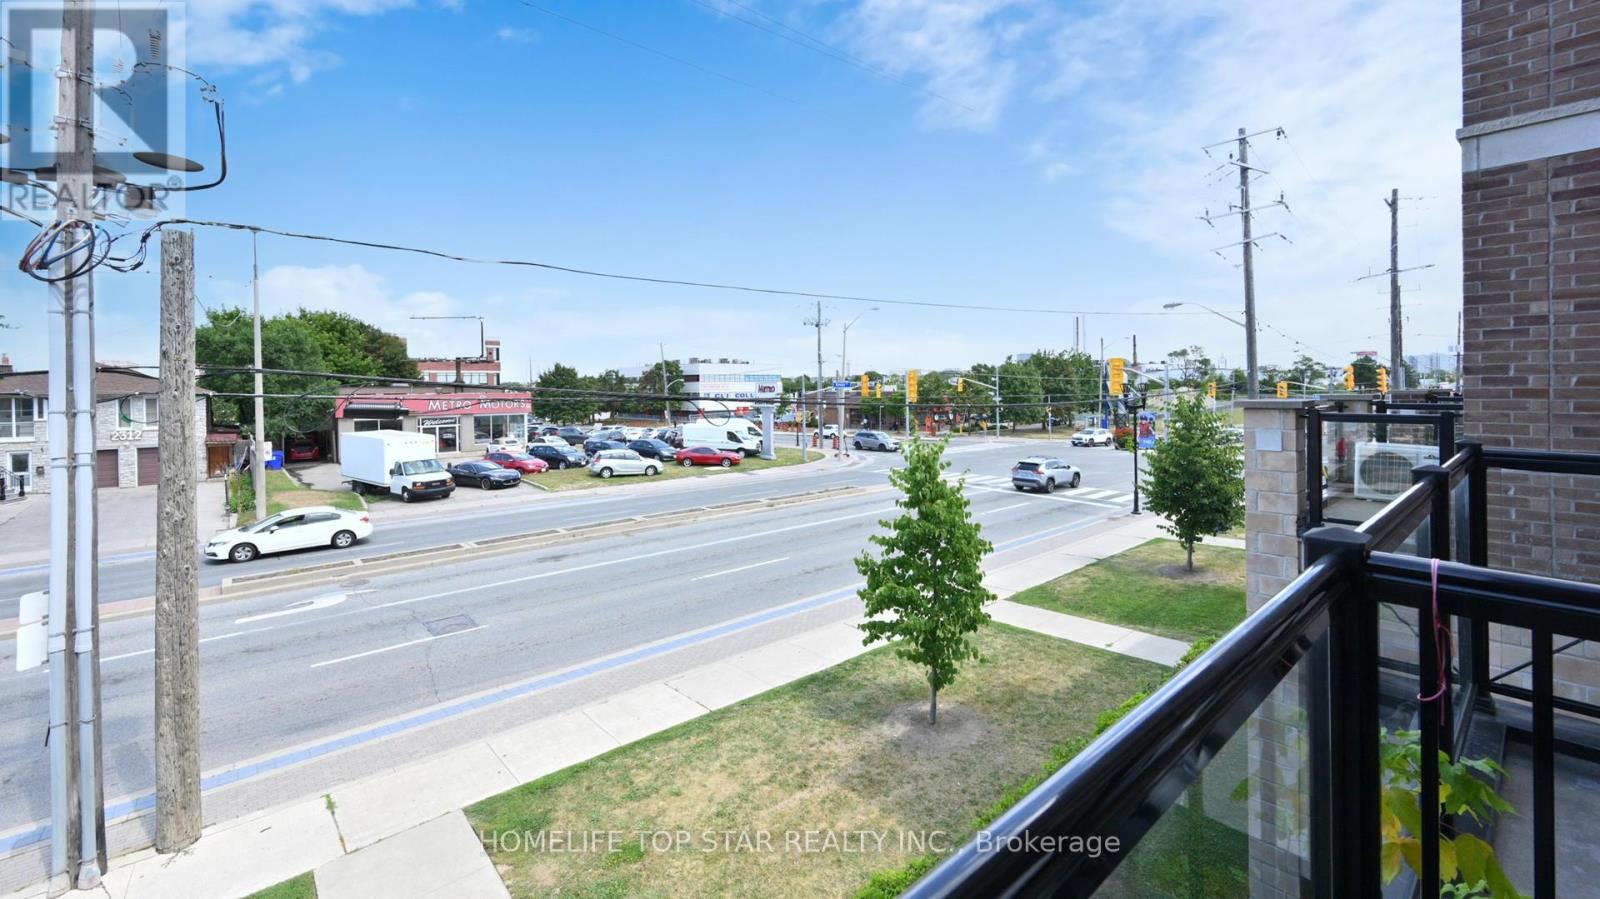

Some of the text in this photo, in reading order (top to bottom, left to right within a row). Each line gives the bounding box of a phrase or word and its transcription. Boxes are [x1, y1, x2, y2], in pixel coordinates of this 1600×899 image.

[428, 400, 472, 411] METRO
[479, 399, 525, 410] MOTORS
[110, 430, 142, 441] 2312
